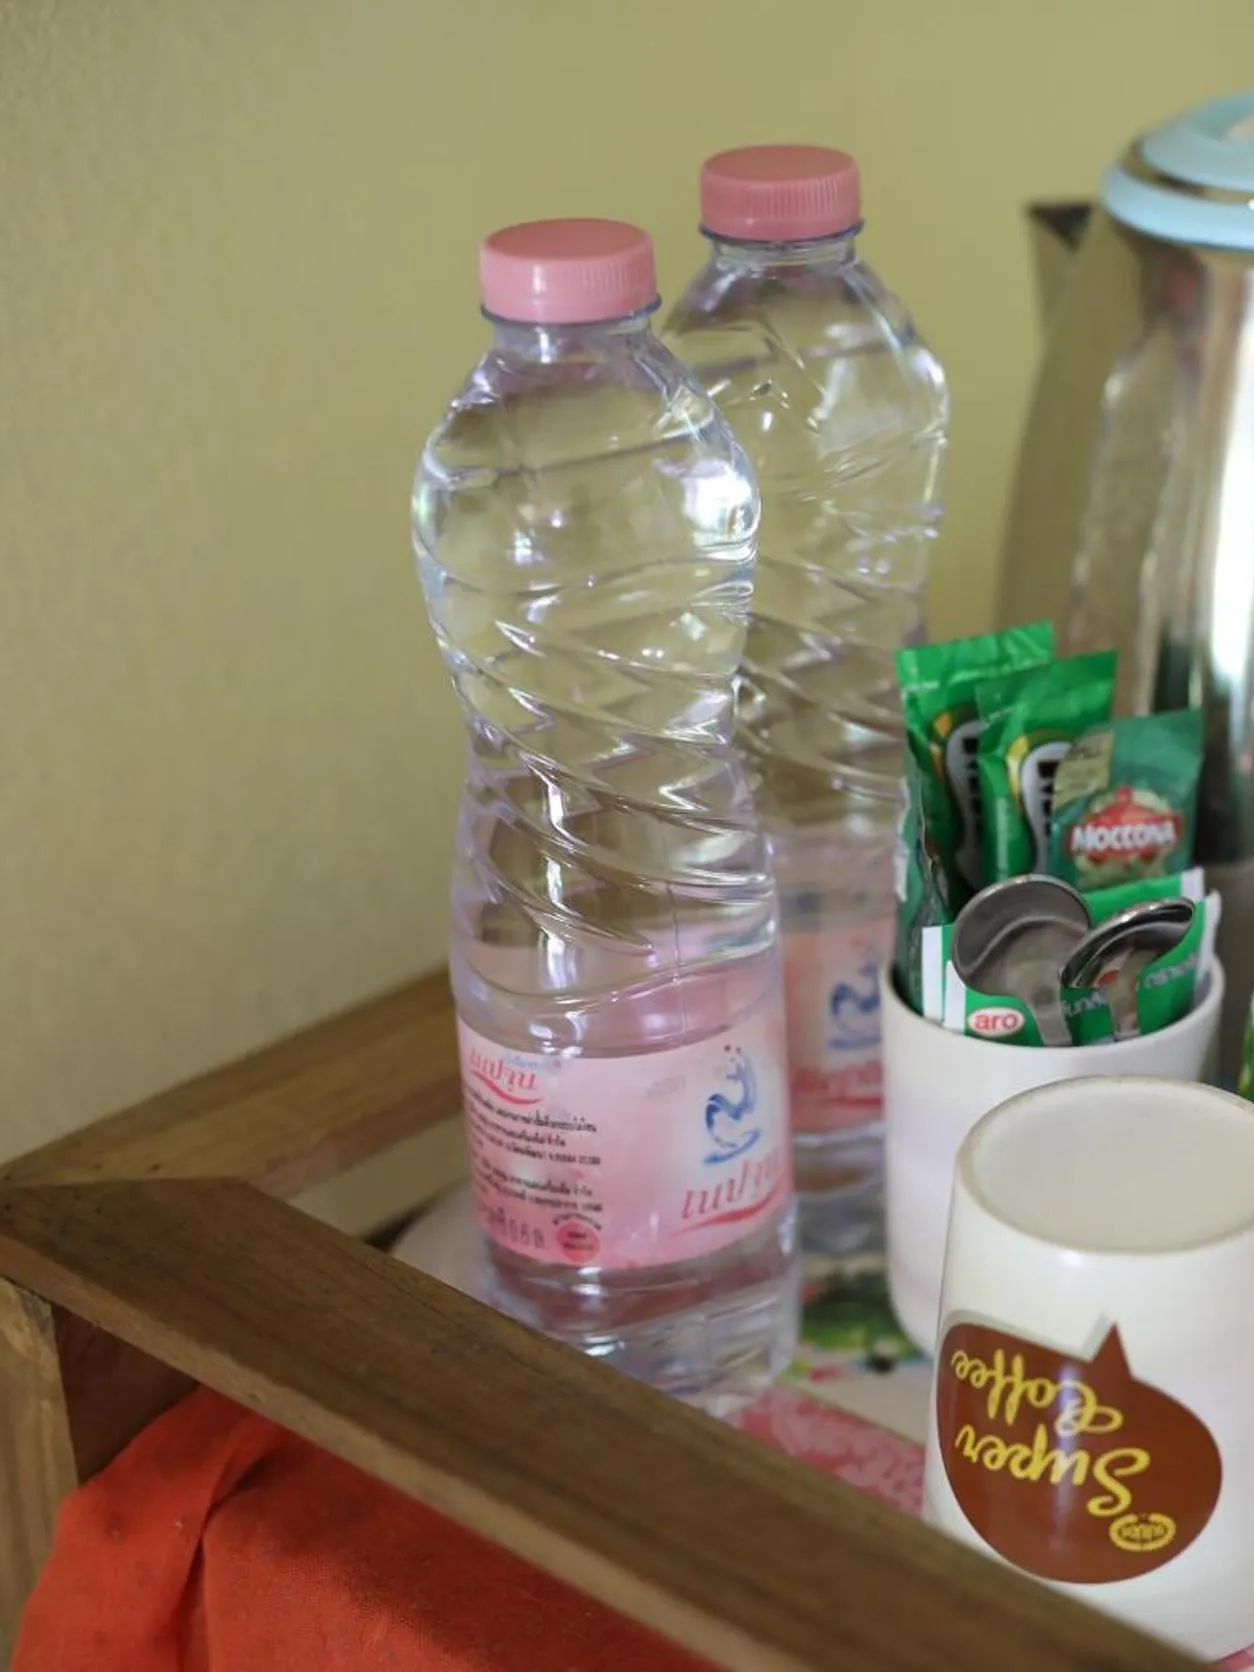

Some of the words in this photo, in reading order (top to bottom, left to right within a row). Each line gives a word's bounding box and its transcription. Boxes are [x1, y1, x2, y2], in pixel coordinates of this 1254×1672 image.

[1071, 819, 1177, 853] MOCCONA
[973, 1010, 1020, 1031] aro
[951, 1347, 1125, 1437] Coffee
[954, 1423, 1151, 1517] Super
